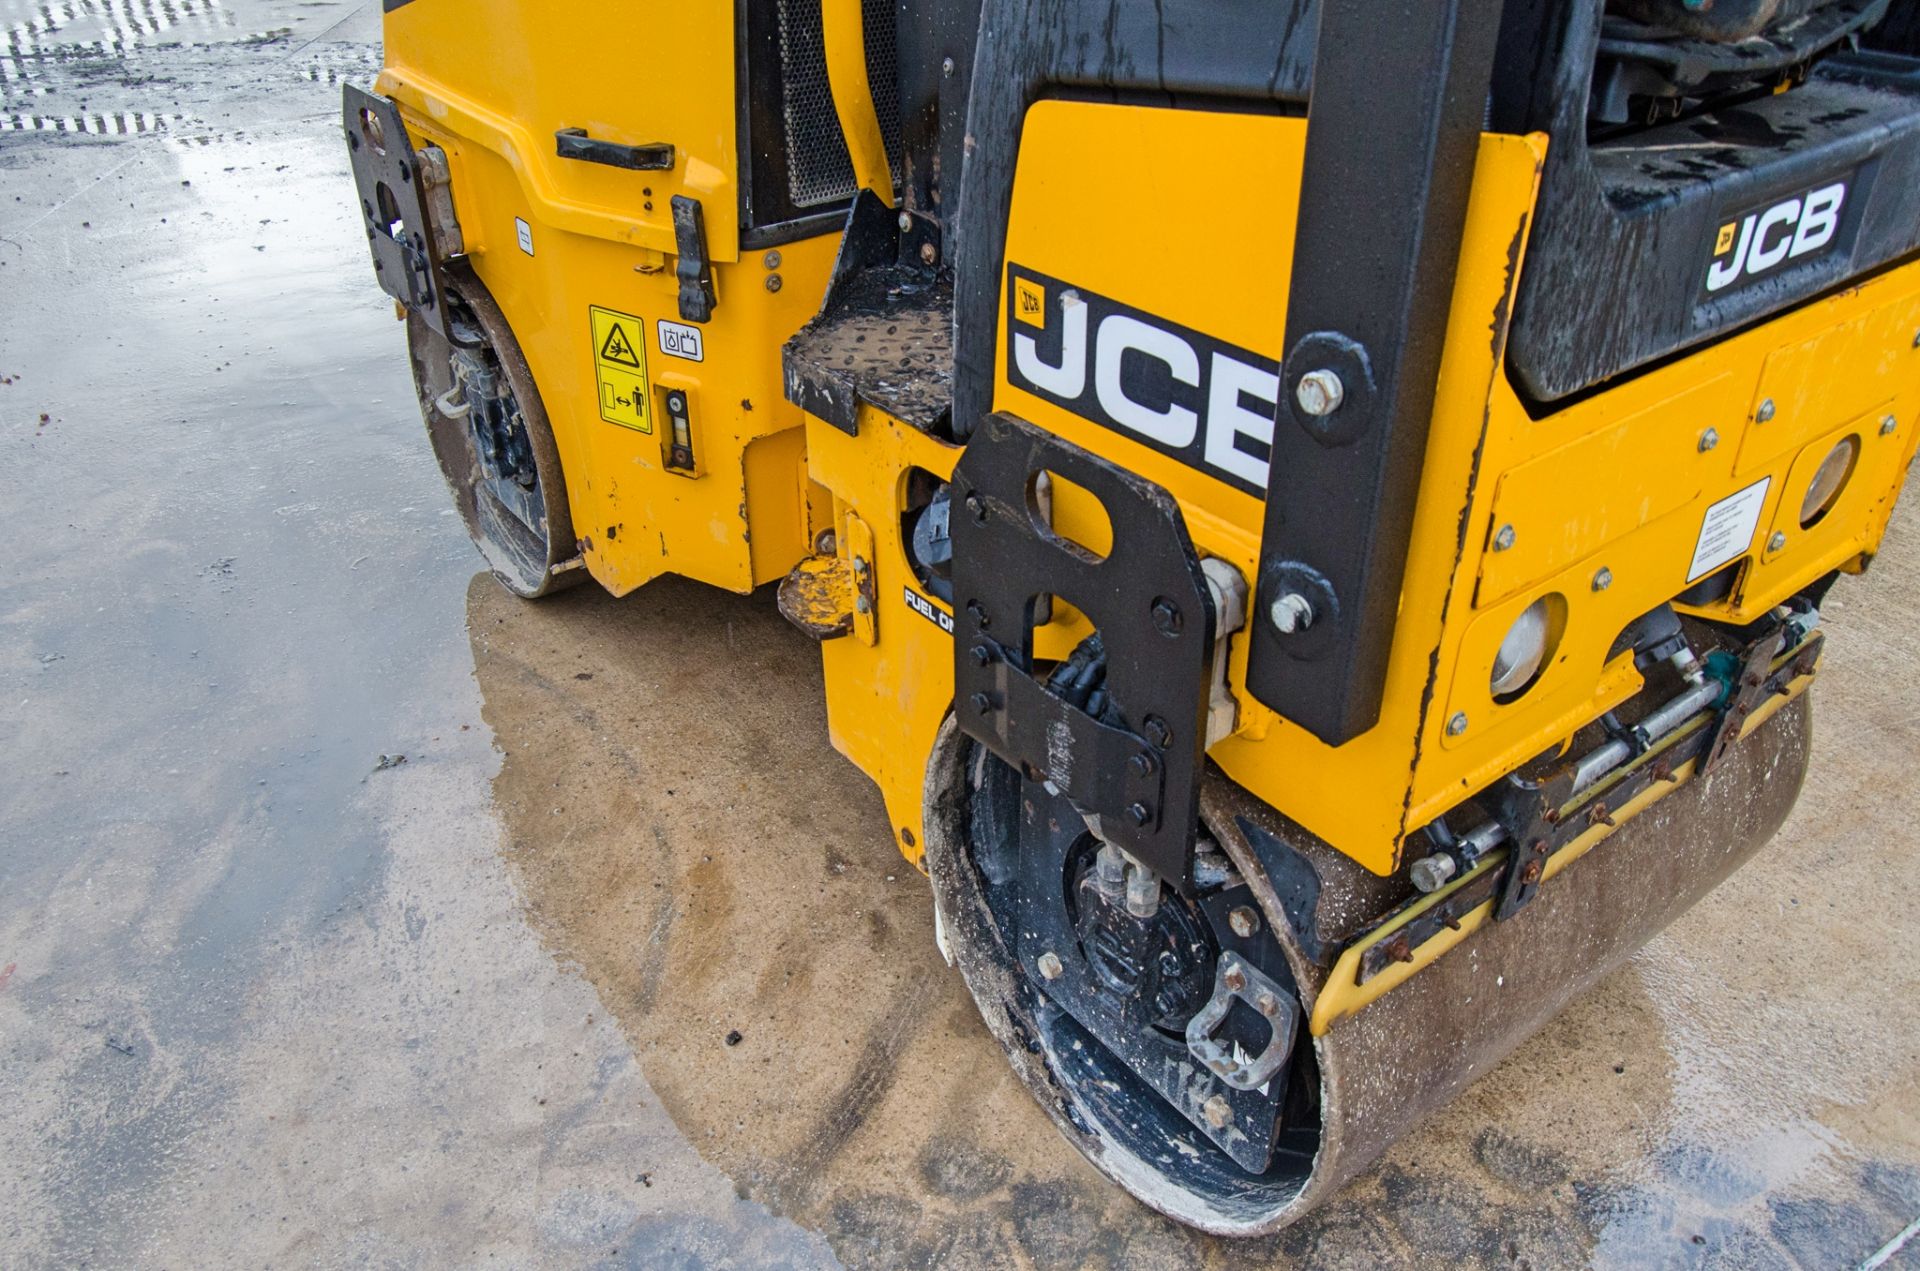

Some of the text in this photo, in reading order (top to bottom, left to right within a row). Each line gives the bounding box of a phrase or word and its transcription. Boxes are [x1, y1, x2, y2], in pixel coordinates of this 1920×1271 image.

[1706, 182, 1845, 291] JCB
[1022, 290, 1040, 312] JCB
[904, 588, 936, 622] FUEL
